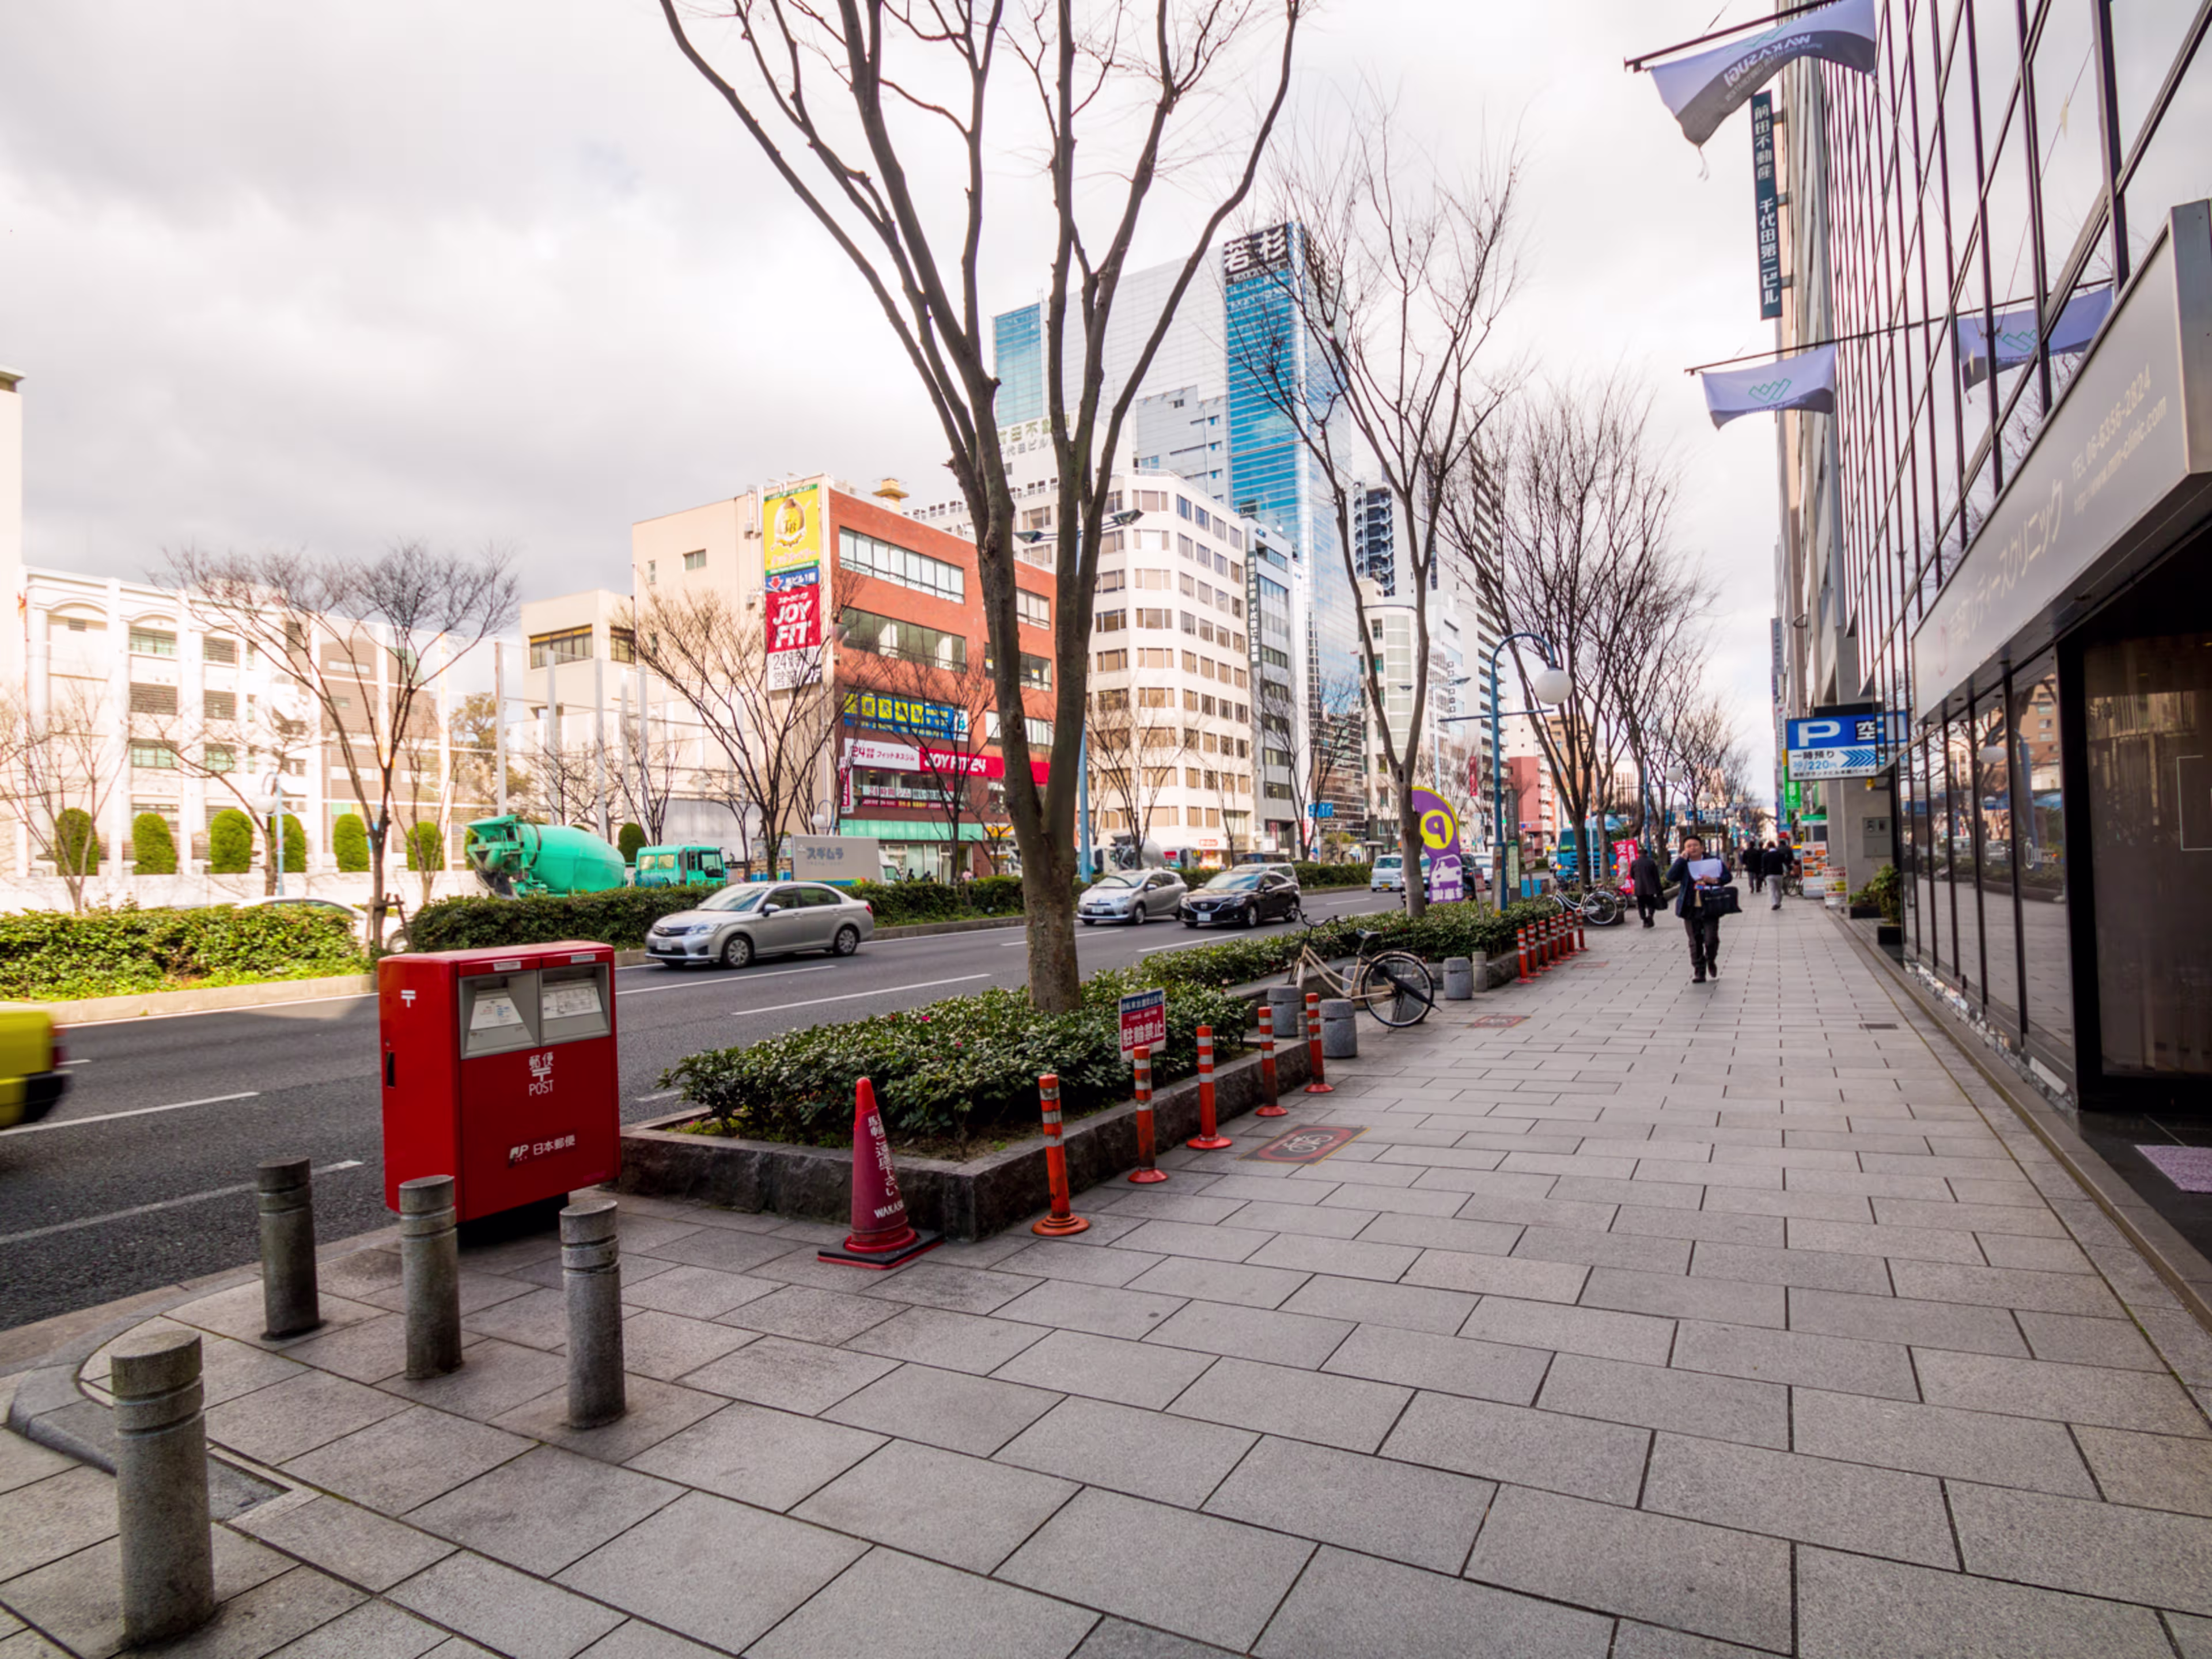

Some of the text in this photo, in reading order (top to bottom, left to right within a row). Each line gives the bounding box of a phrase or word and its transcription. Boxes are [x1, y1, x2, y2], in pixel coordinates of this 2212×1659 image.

[1754, 104, 1779, 305] 前田不動産 千代田第二ビル
[1224, 228, 1286, 272] 若杉
[772, 600, 812, 625] JOY
[775, 620, 812, 648] FIT
[1798, 721, 1841, 747] P
[1856, 721, 1877, 741] 空
[924, 752, 950, 768] JOY
[970, 757, 987, 773] 24
[806, 847, 844, 859] スギムラ
[1123, 1019, 1164, 1047] 駐輪禁止
[529, 1051, 554, 1070] 郵便
[529, 1080, 554, 1097] POST
[533, 1134, 575, 1156] 日本郵便
